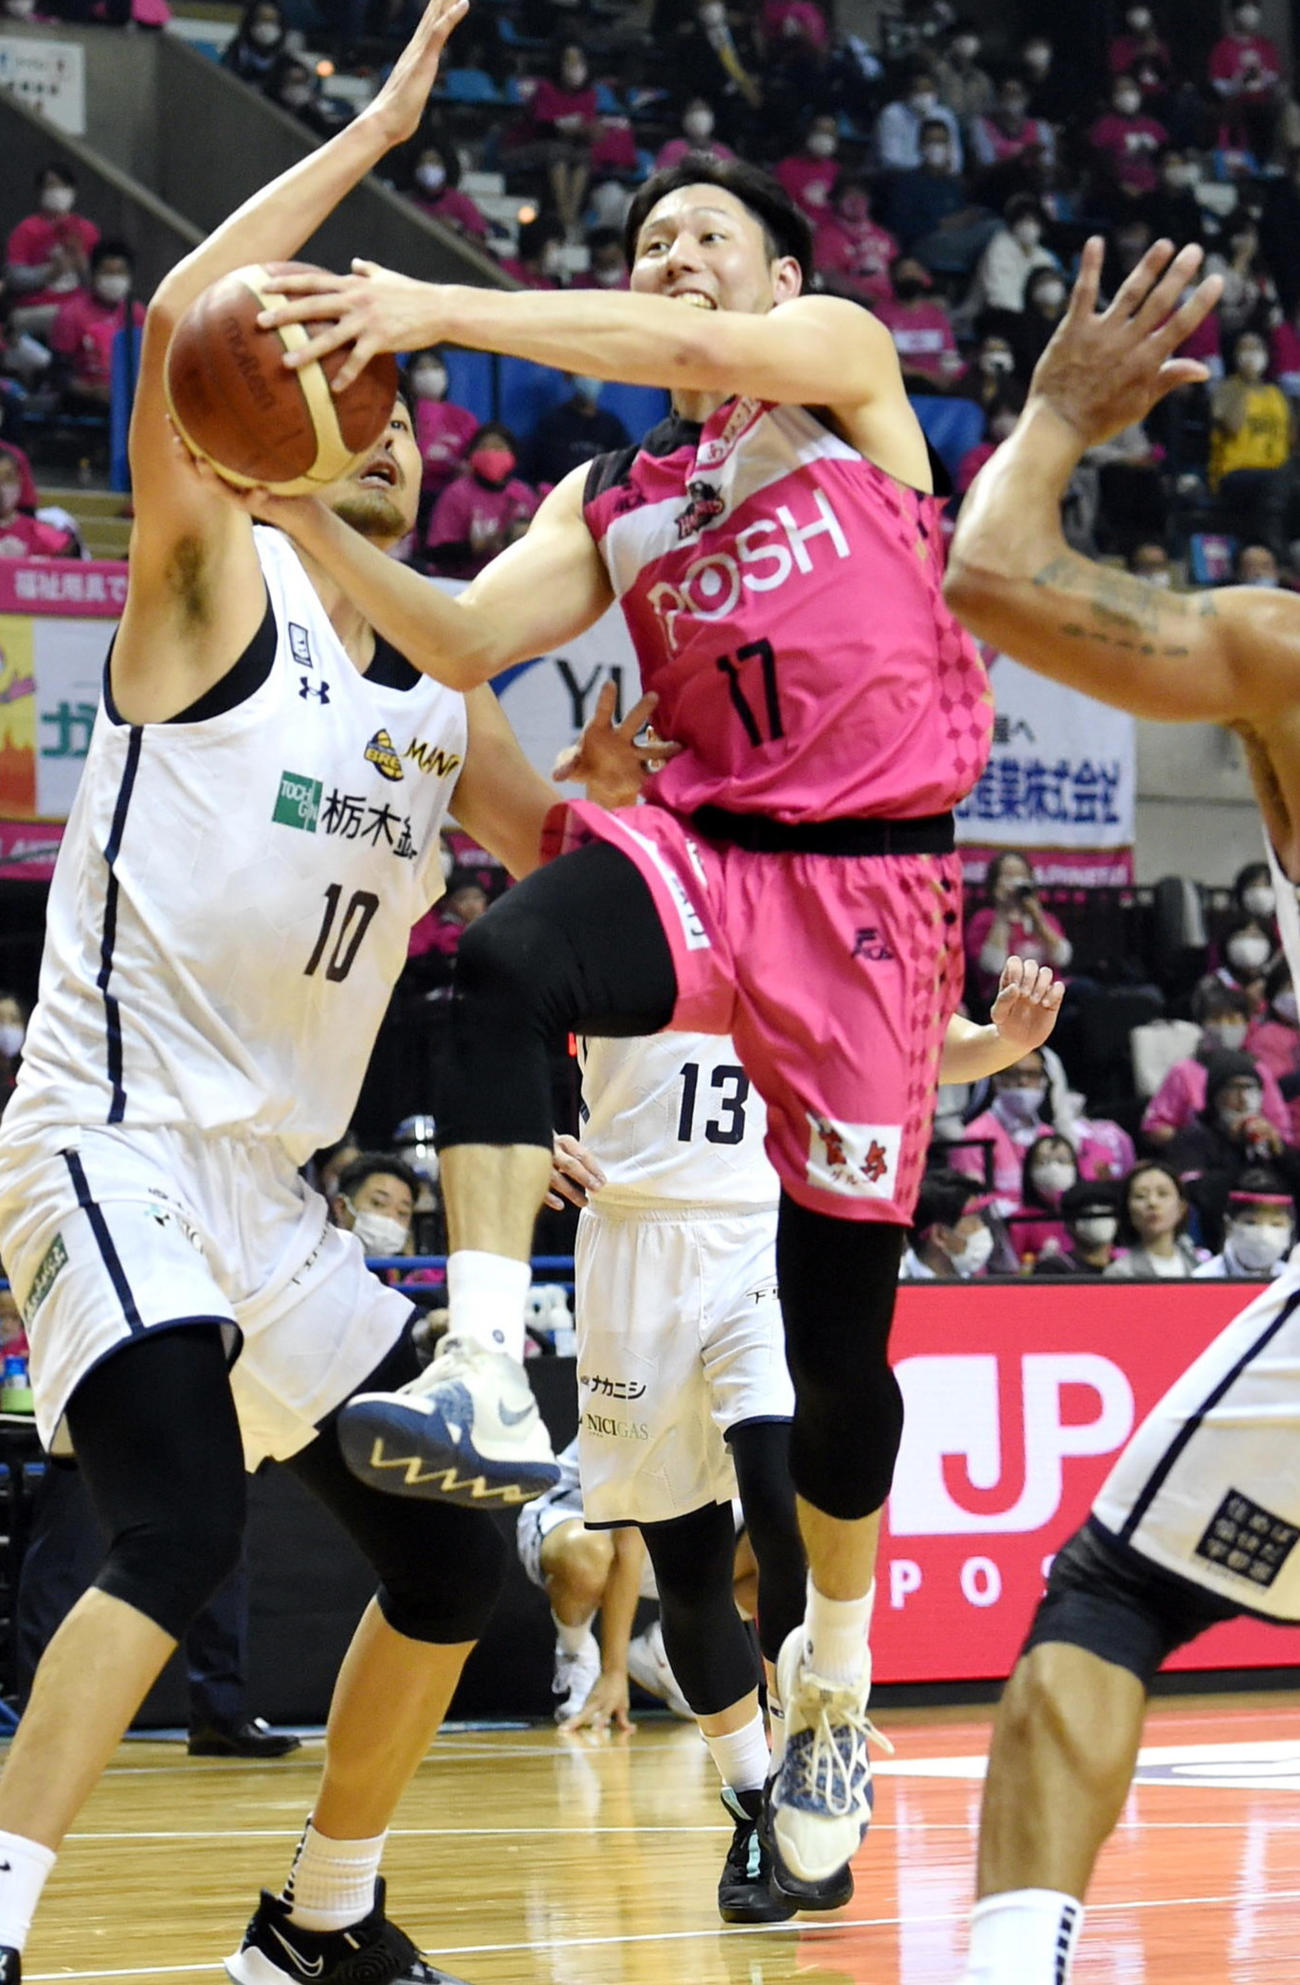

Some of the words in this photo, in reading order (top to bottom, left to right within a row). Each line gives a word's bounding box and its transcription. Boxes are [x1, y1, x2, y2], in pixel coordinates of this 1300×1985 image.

[646, 487, 851, 650] POSH
[716, 637, 785, 747] 17
[303, 883, 380, 983] 10
[678, 1062, 751, 1145] 13
[587, 1413, 649, 1441] NICIGAS
[591, 1374, 647, 1400] ナカニシ
[898, 1352, 1136, 1536] JP
[888, 1554, 1056, 1610] PO
